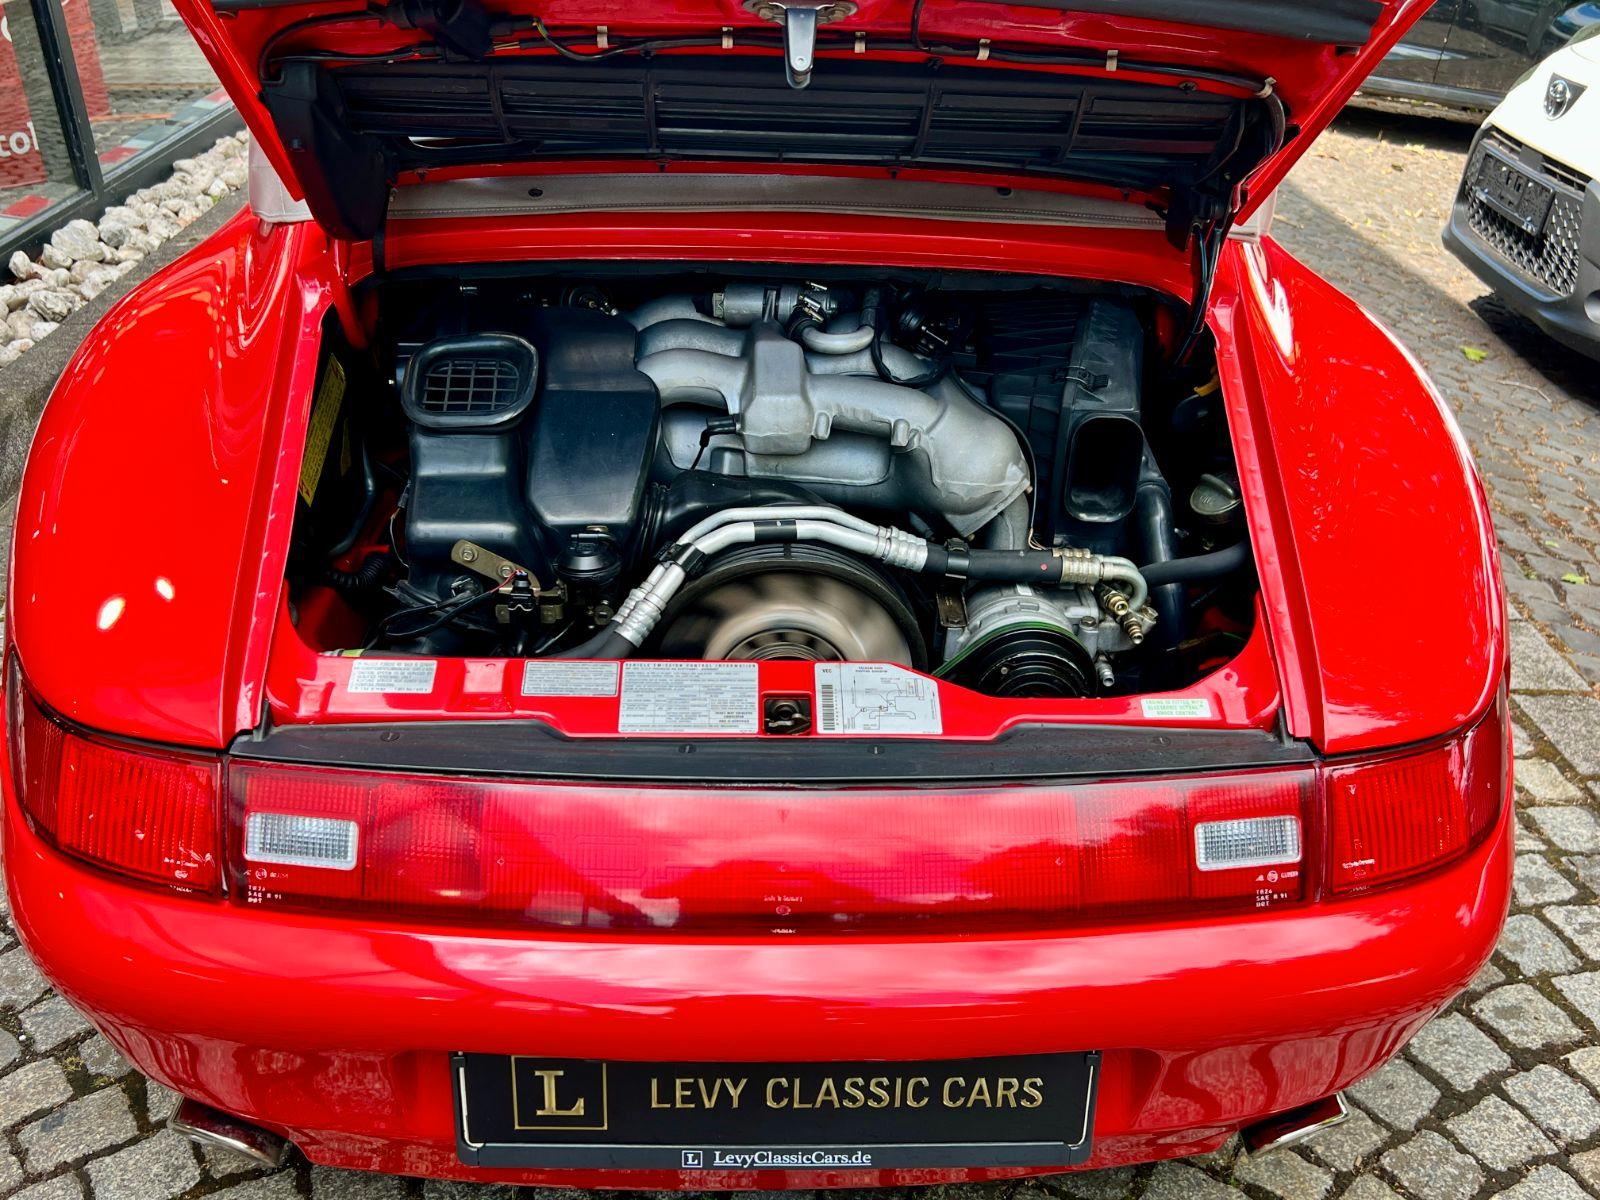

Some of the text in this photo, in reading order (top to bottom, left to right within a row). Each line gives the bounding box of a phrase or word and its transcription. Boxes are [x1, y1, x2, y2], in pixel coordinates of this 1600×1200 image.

[535, 1070, 584, 1116] L
[651, 1076, 1044, 1109] LEVY CLASSIC CARS
[713, 1151, 871, 1168] LevyClassicCars.de
